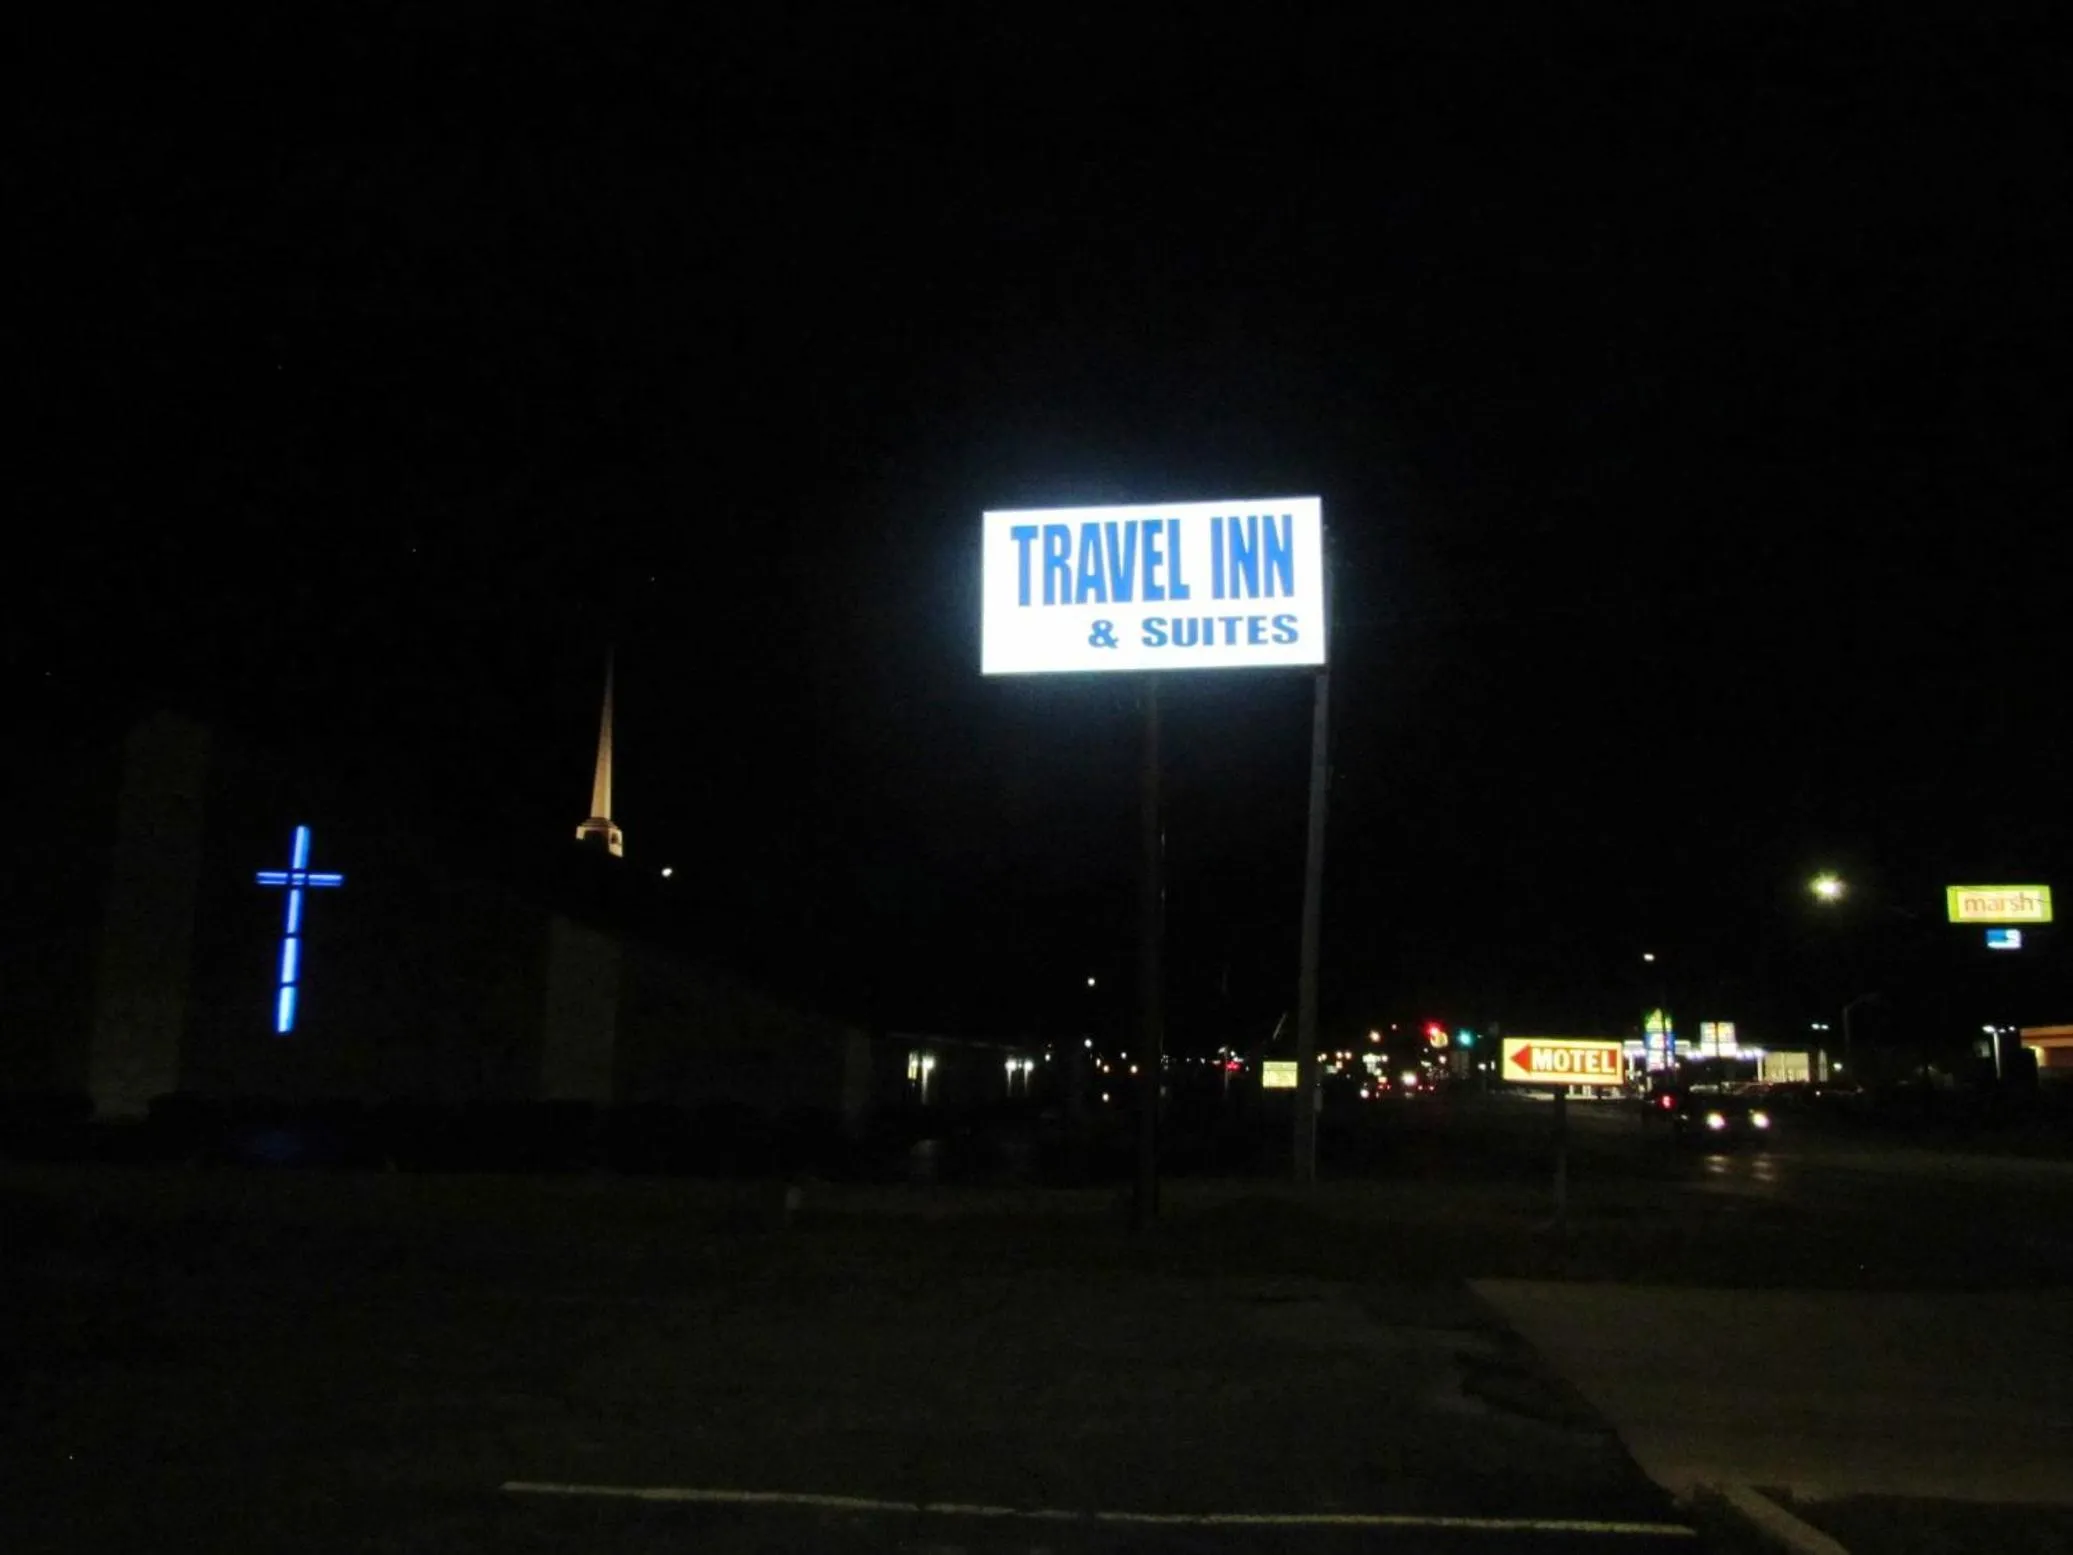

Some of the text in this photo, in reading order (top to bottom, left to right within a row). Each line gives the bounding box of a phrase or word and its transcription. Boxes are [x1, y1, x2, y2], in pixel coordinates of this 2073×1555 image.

[1010, 514, 1295, 607] TRAVEL INN
[1088, 614, 1299, 649] & SUITES
[1964, 892, 2034, 912] marsh
[1531, 1047, 1616, 1074] MOTEL
